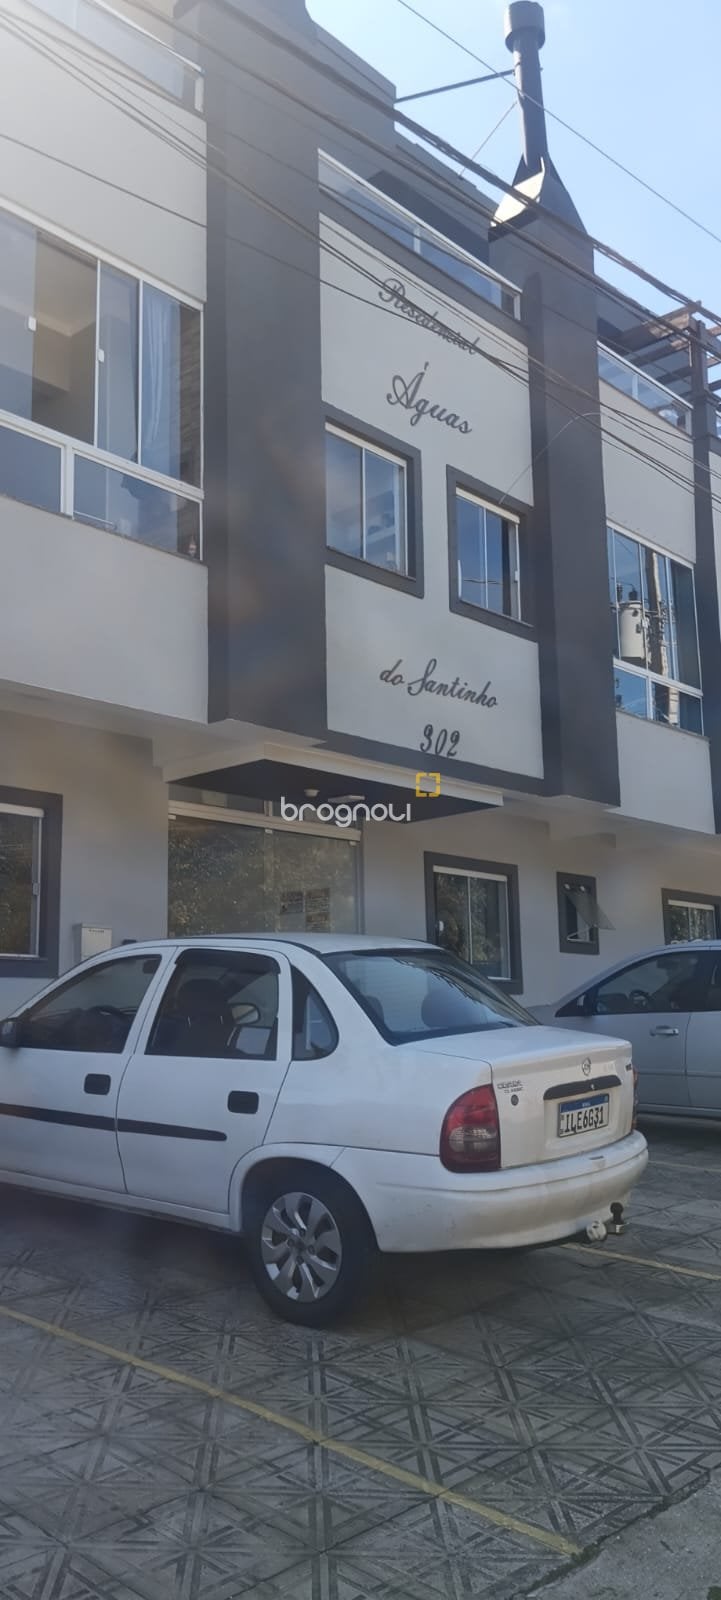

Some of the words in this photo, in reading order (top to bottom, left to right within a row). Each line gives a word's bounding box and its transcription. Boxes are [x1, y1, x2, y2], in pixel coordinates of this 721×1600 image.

[386, 361, 472, 434] Águas
[380, 659, 404, 686] do
[407, 658, 498, 708] Santinho
[420, 724, 460, 757] 302
[564, 1106, 604, 1133] ILE6G31
